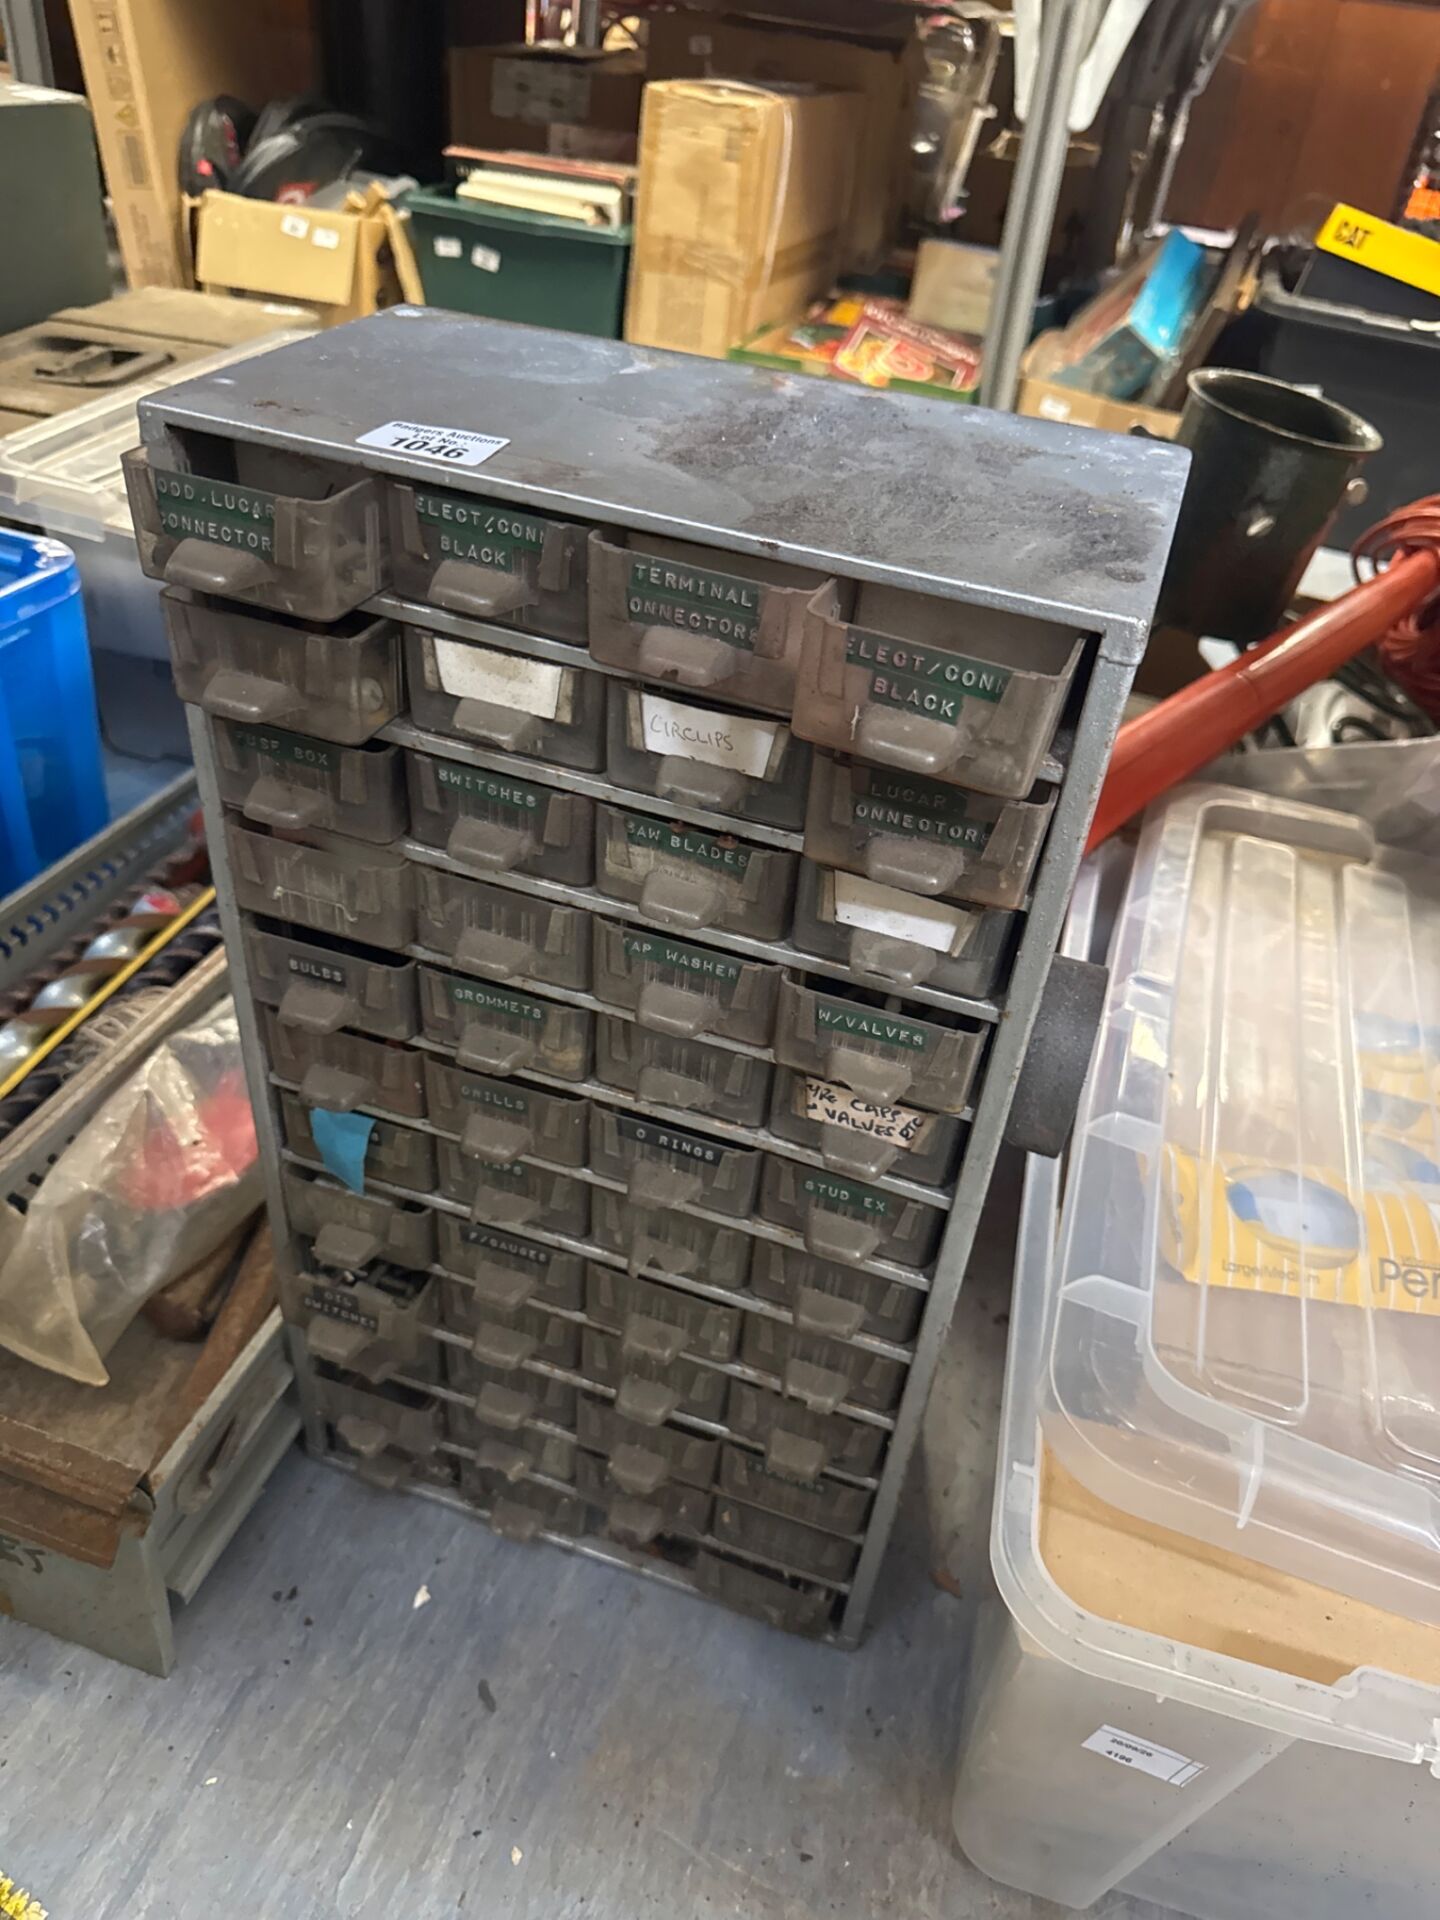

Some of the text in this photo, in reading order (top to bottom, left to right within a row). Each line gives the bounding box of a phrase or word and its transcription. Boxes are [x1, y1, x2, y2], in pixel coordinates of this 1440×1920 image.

[1334, 219, 1374, 250] CAT
[389, 437, 469, 459] 1046
[412, 433, 433, 442] Lot
[447, 431, 503, 445] Auctions
[440, 535, 507, 566] BLACK
[635, 563, 753, 607] TERMINAL
[873, 677, 955, 717] BLACK
[650, 713, 734, 751] CIRCLIPS
[294, 746, 329, 766] BOX
[438, 768, 537, 808] SWITCHES
[669, 834, 748, 868] BLADES
[623, 937, 653, 953] AP
[289, 958, 342, 982] BULBS
[454, 988, 542, 1019] GROMMETS
[818, 1008, 924, 1046] W/VALVES
[635, 1128, 715, 1161] O RINGS
[804, 1180, 886, 1213] STUD EX
